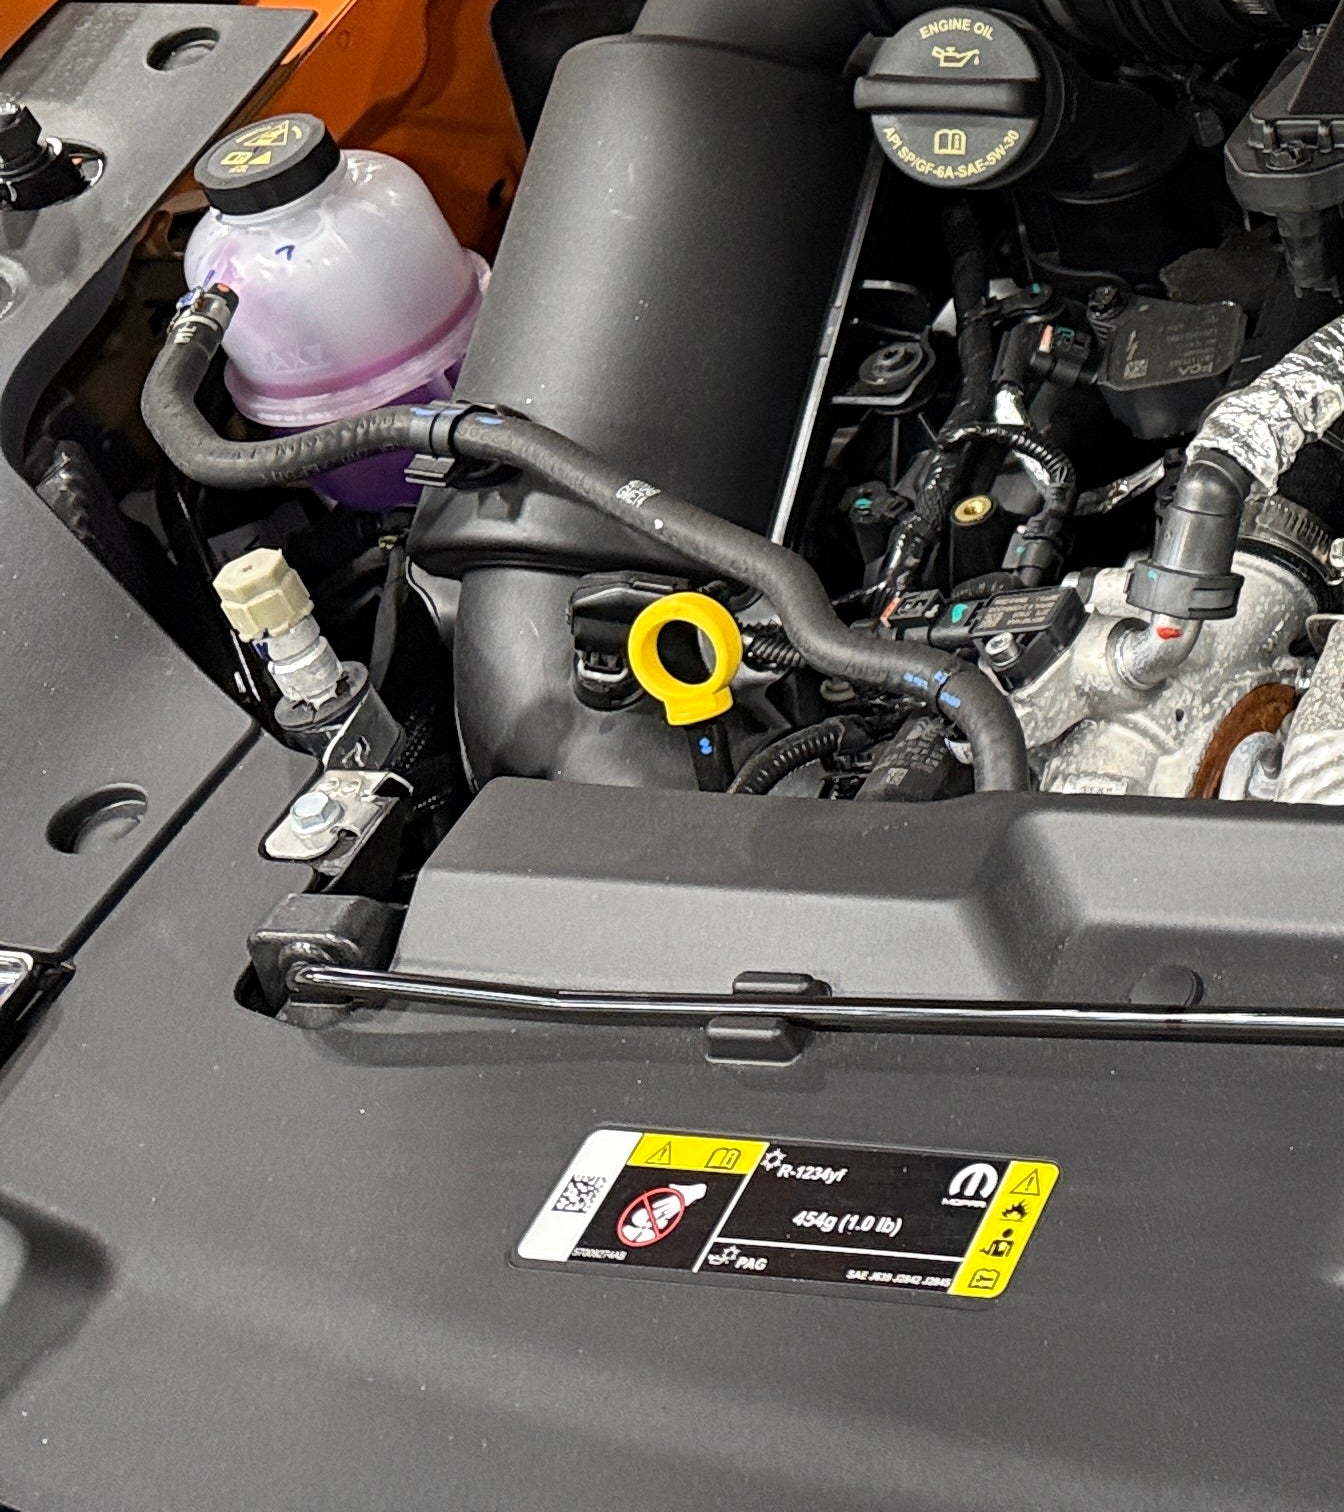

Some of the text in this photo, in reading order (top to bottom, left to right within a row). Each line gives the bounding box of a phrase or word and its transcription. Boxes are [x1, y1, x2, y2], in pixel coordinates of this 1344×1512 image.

[919, 18, 995, 40] ENGINE OIL
[882, 127, 900, 151] API
[776, 1162, 847, 1185] R-1234yf
[792, 1209, 904, 1237] 454g (1.0 lb)
[734, 1254, 768, 1272] PAG
[846, 1269, 869, 1280] SAE
